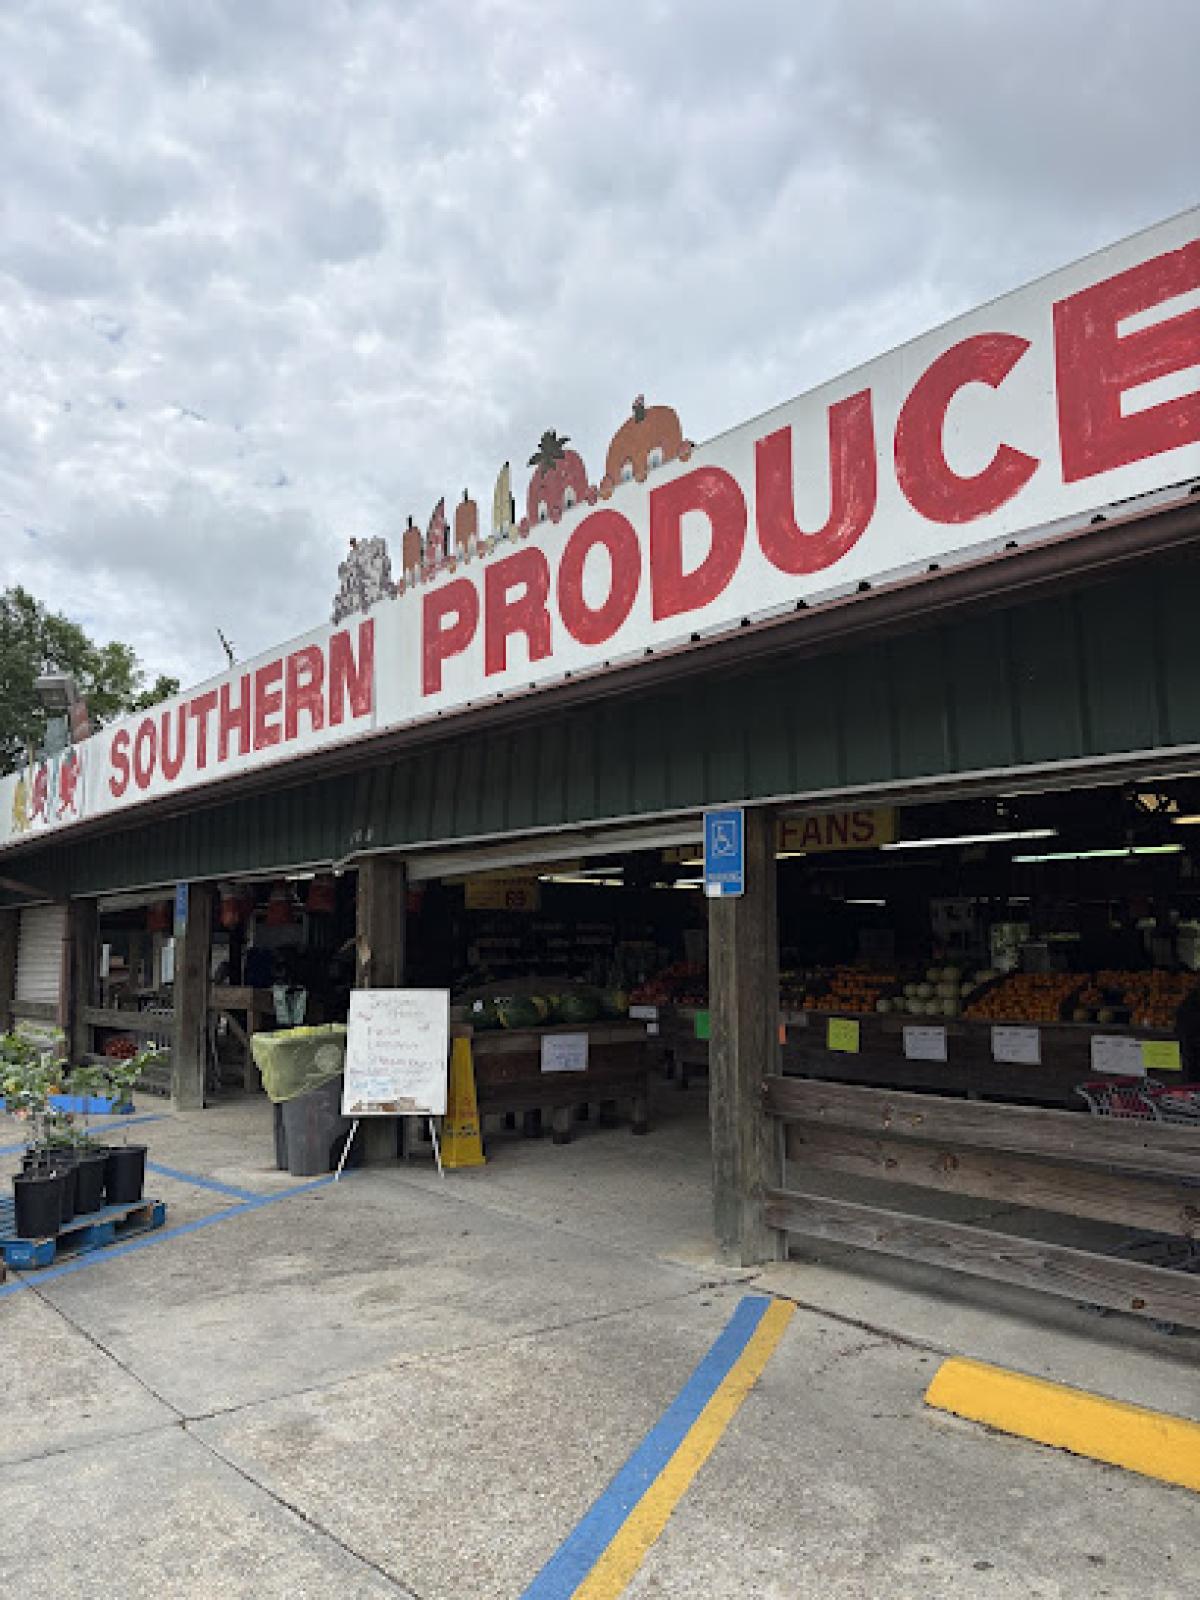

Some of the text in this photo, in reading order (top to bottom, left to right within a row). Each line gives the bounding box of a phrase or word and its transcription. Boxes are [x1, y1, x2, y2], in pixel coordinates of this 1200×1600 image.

[109, 238, 1200, 797] SOUTHERN PRODUCE
[779, 811, 876, 849] FANS
